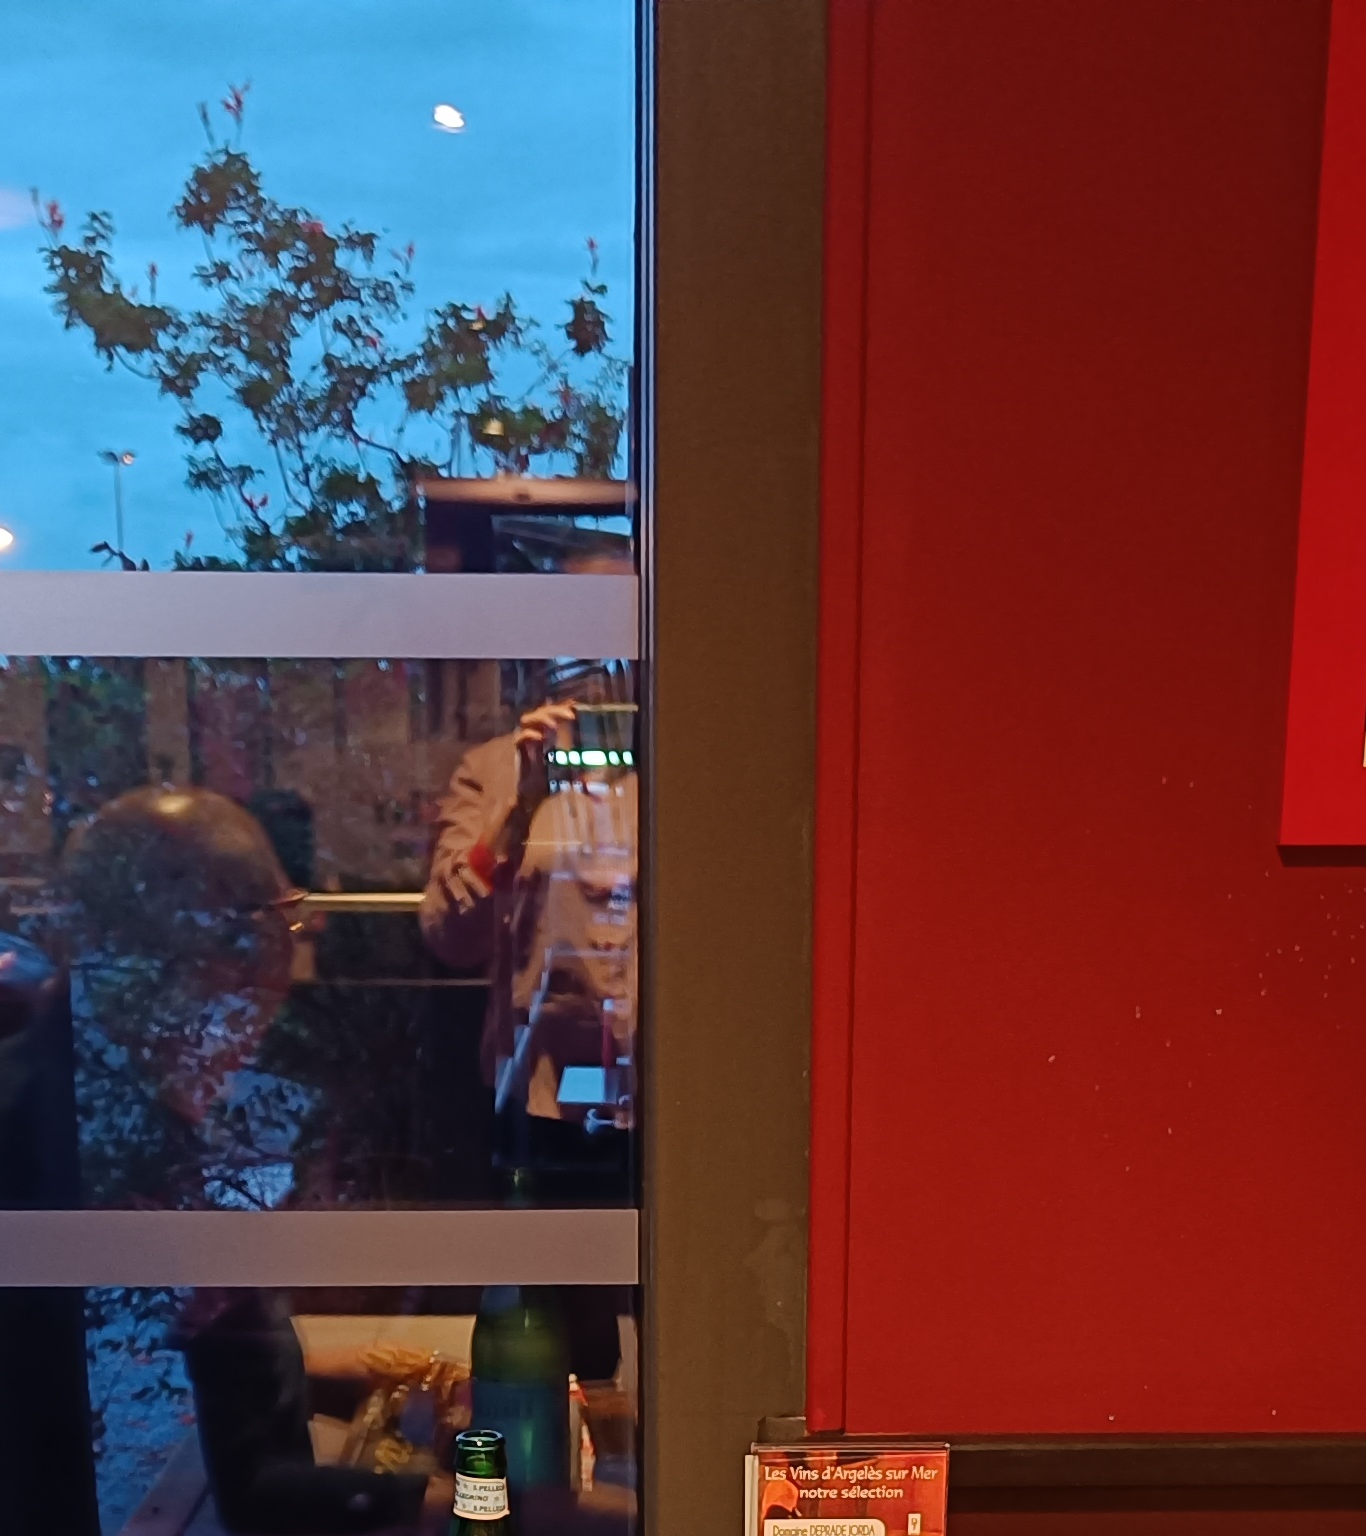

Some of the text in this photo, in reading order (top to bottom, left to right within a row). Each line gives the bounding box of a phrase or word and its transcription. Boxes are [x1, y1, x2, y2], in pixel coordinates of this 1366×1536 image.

[765, 1466, 937, 1483] Les Vins d'Argelès sur Mer
[800, 1485, 903, 1498] notre sélection
[773, 1525, 808, 1536] Domaine
[810, 1525, 846, 1536] DEPRADE
